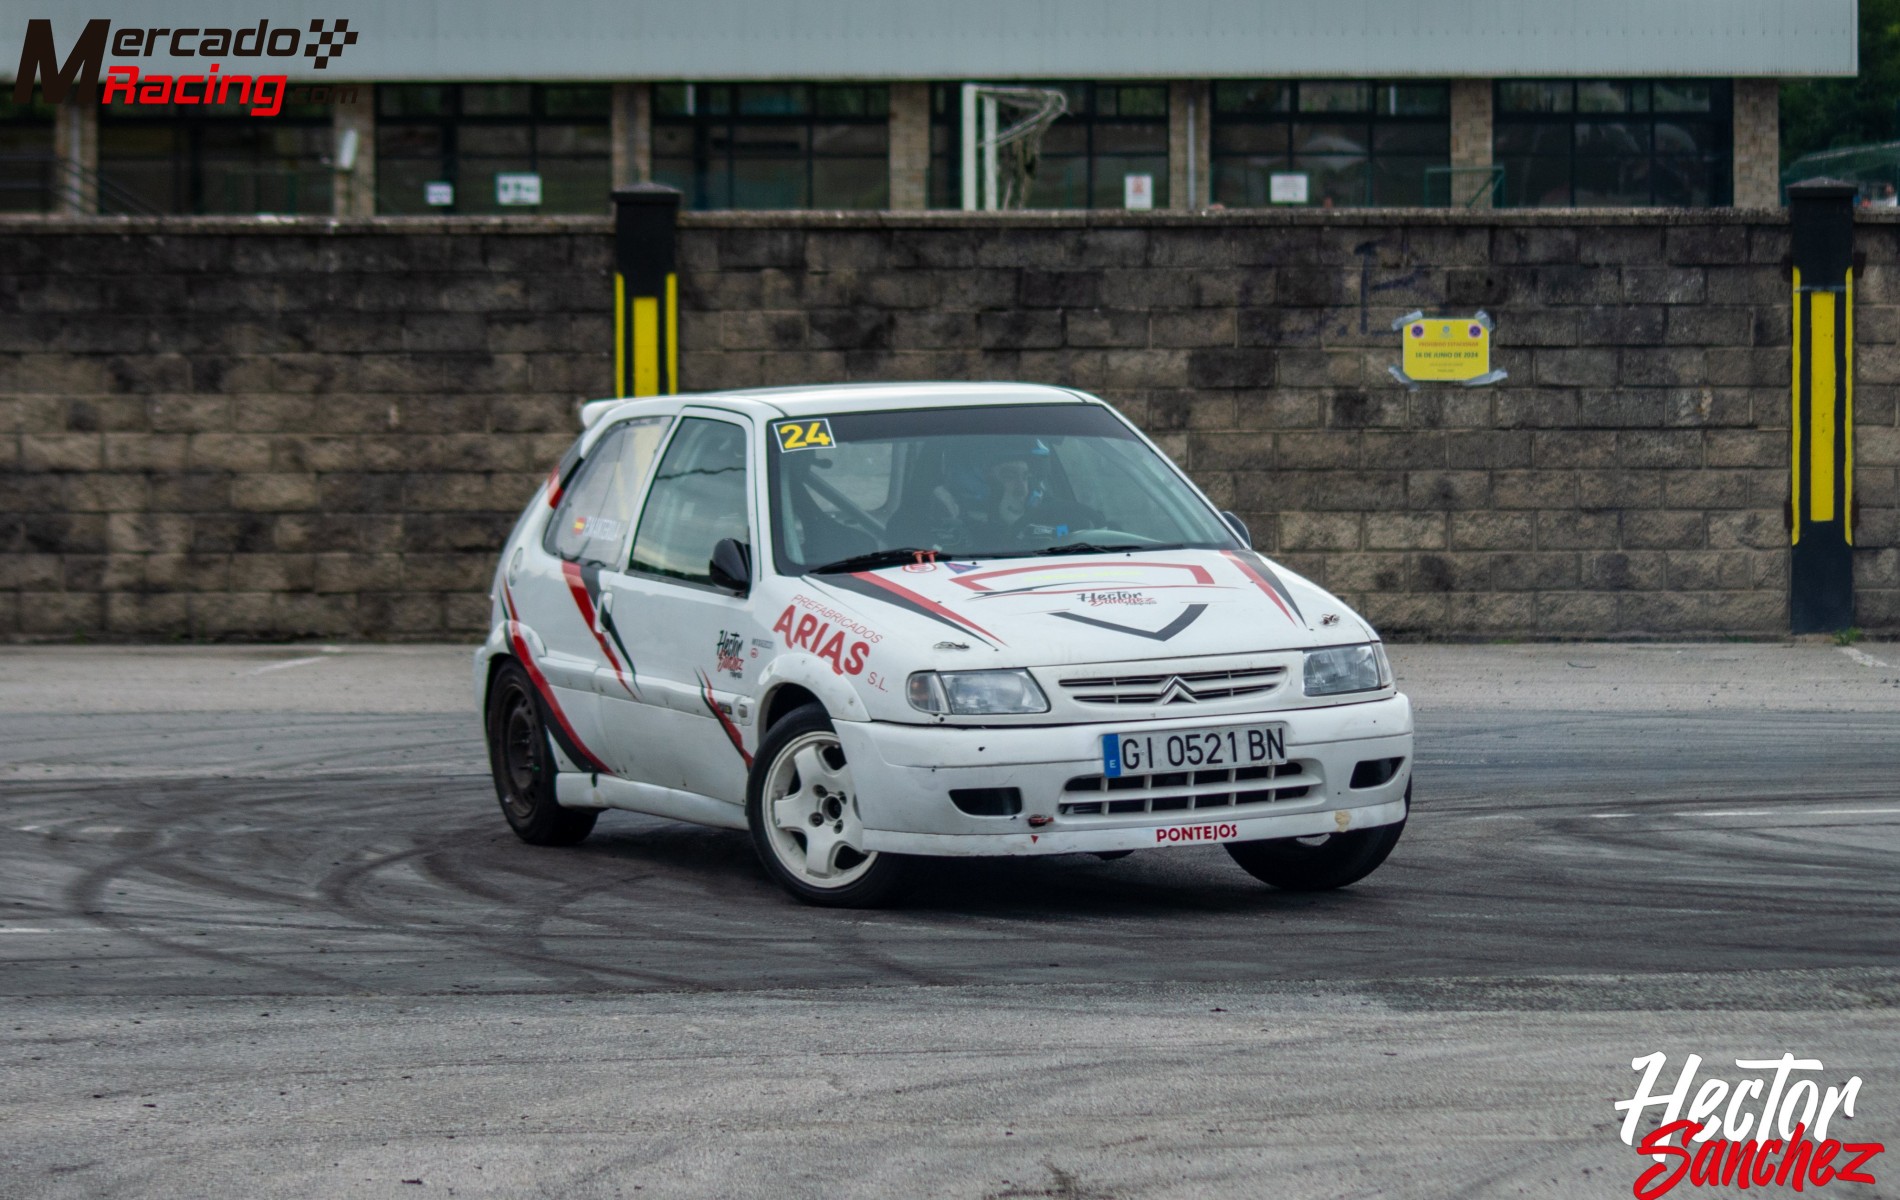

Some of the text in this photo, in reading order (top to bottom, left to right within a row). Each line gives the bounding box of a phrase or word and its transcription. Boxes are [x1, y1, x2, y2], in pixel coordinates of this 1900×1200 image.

[780, 422, 831, 449] 24
[1076, 591, 1142, 602] Hector
[791, 594, 883, 644] PREFABRICADOS
[772, 604, 870, 676] ARIAS
[867, 671, 889, 693] S.L.
[1121, 727, 1285, 770] GI 0521 BN
[1109, 759, 1117, 769] E
[1156, 823, 1238, 843] PONTEJOS
